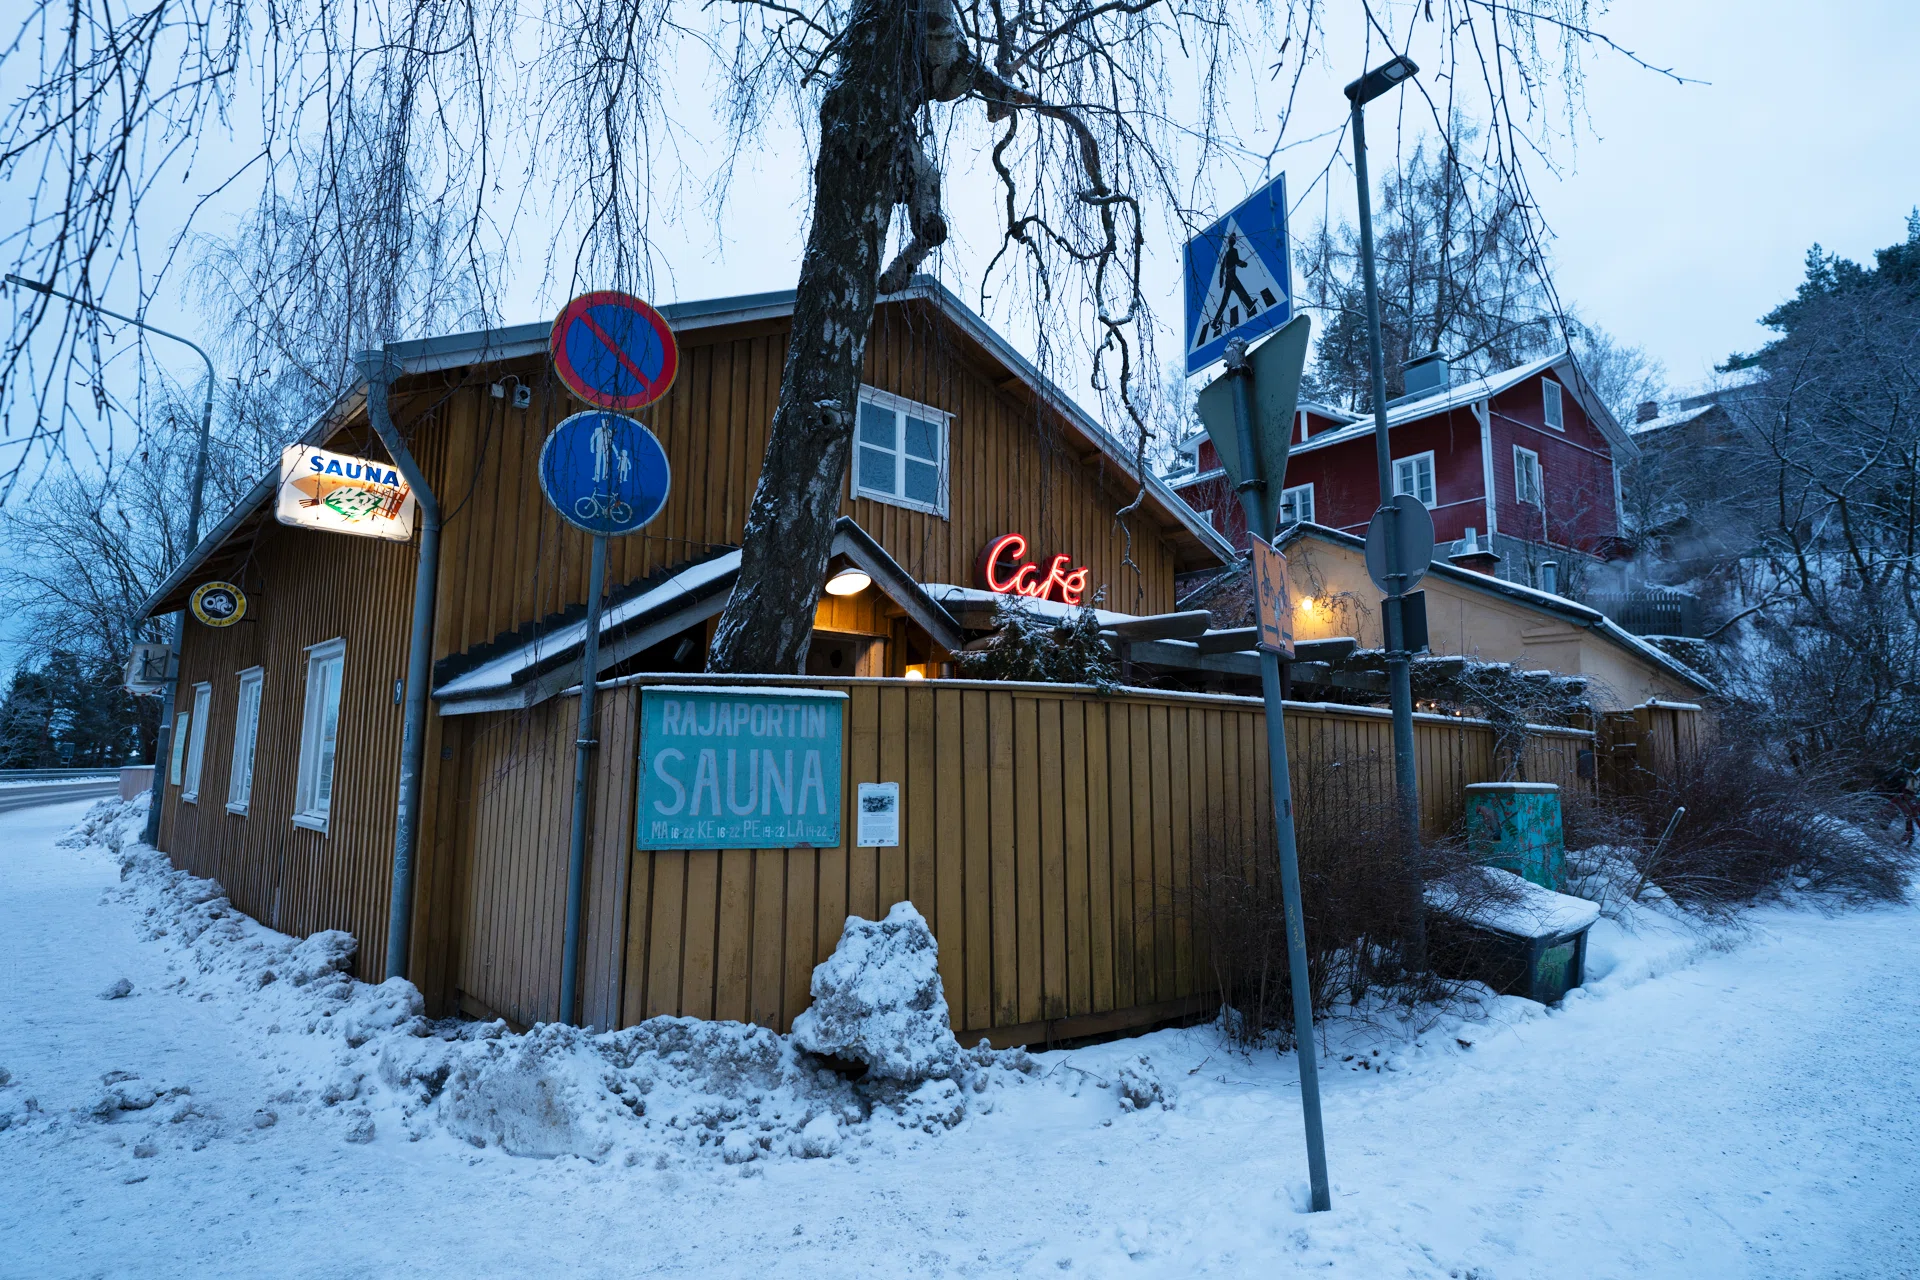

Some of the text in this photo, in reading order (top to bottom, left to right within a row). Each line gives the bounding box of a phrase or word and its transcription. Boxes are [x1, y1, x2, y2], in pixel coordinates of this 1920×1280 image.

[309, 455, 399, 487] SAUNA
[396, 682, 402, 701] 9
[662, 700, 827, 738] RAJAPORTIN
[653, 748, 827, 816] SAUNA
[652, 821, 668, 839] MA
[671, 827, 695, 839] 16-22
[698, 820, 715, 838] KE
[717, 826, 740, 838] 16-22
[743, 819, 761, 838] PE
[787, 819, 804, 837] LA
[806, 825, 827, 837] 14-22
